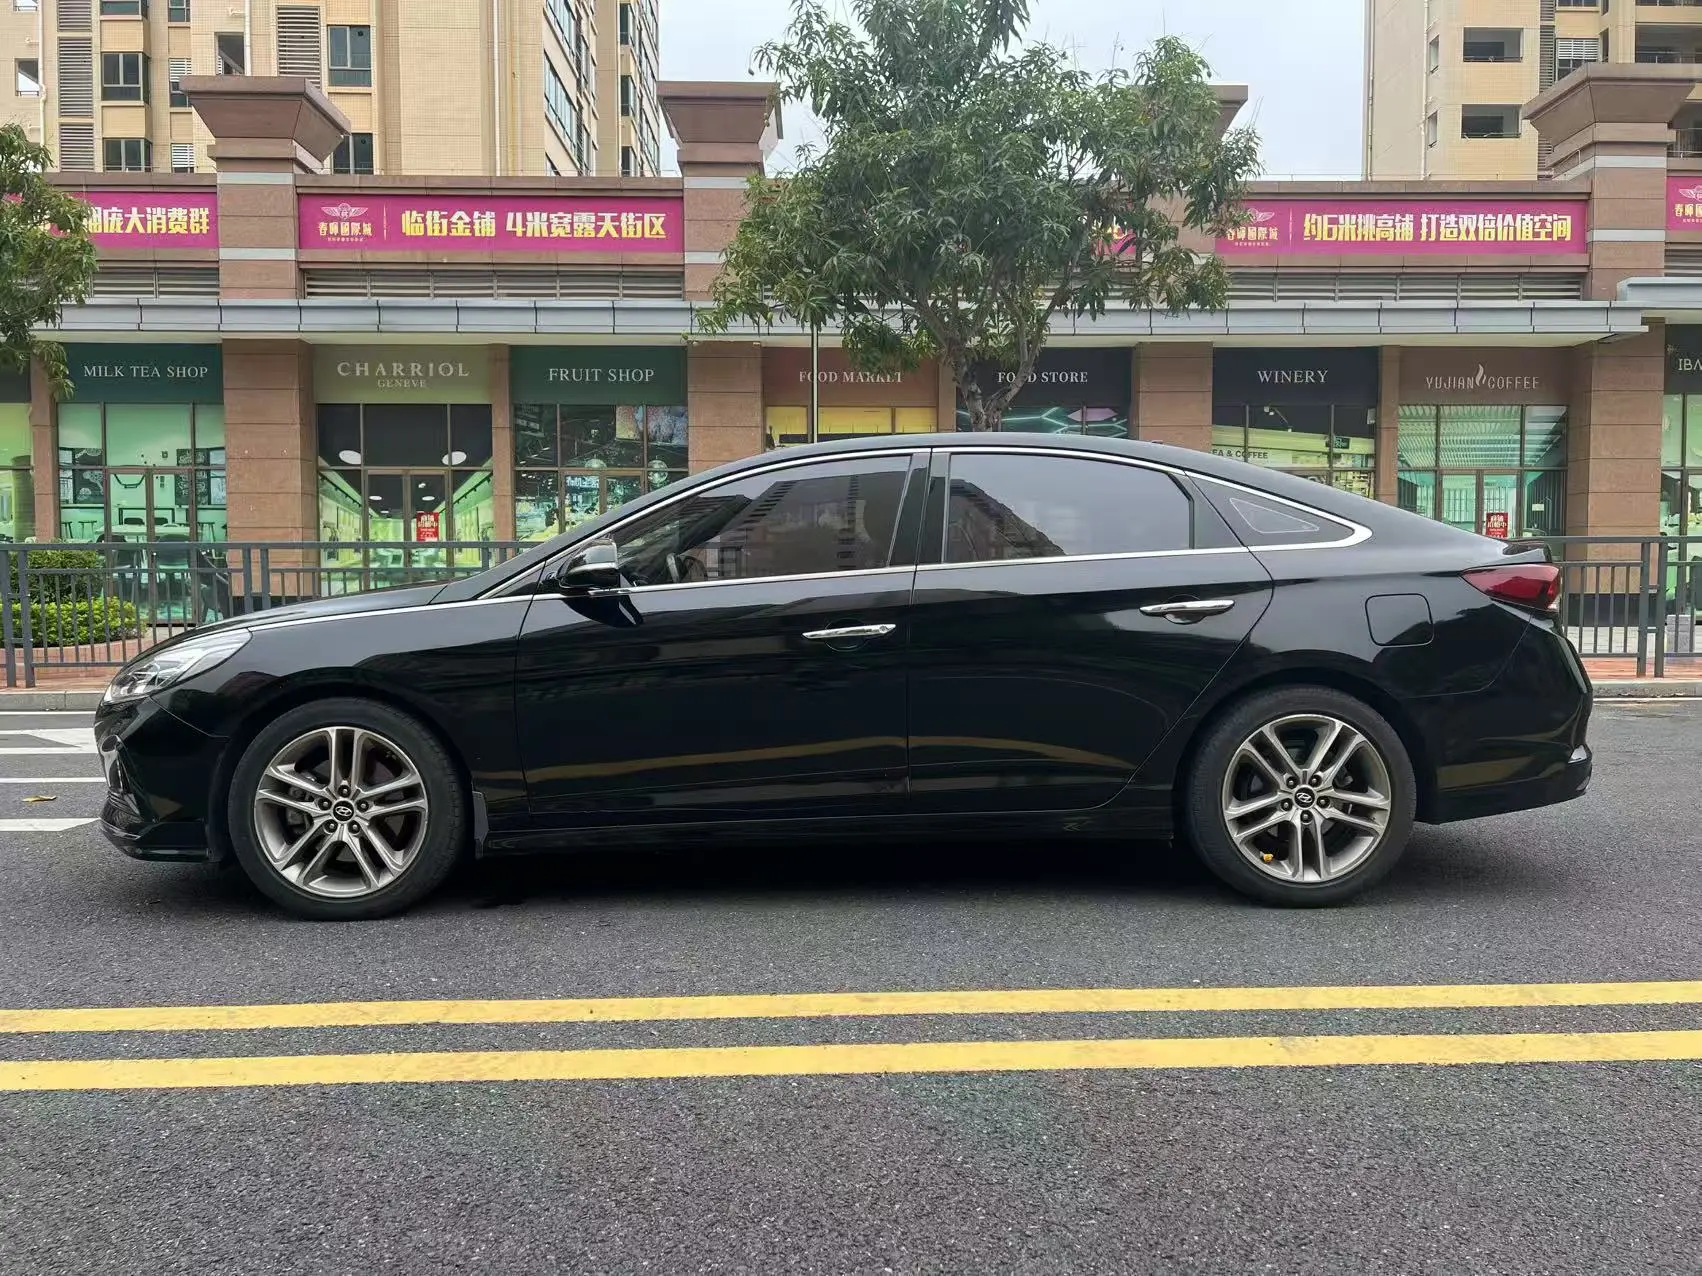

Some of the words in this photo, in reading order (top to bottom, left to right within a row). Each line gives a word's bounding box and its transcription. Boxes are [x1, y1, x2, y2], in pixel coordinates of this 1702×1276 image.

[401, 210, 496, 239] 临街金铺
[505, 211, 667, 239] 4米宽露天街区
[1303, 213, 1414, 241] 约6米挑高铺
[1420, 213, 1573, 242] 打造双倍价值空间
[83, 365, 125, 378] MILK
[129, 365, 161, 378] TEA
[166, 365, 208, 378] SHOP
[337, 361, 470, 377] CHARRIOL
[548, 368, 602, 382] FRUIT
[607, 368, 654, 382] SHOP
[997, 371, 1037, 383] FOD
[1041, 371, 1088, 383] STORE
[1257, 370, 1328, 383] WINERY
[1425, 376, 1474, 389] YUJIAN
[1487, 376, 1539, 389] COFFEE
[377, 379, 427, 389] GENEVE
[1209, 448, 1224, 457] EA
[1226, 449, 1233, 457] &
